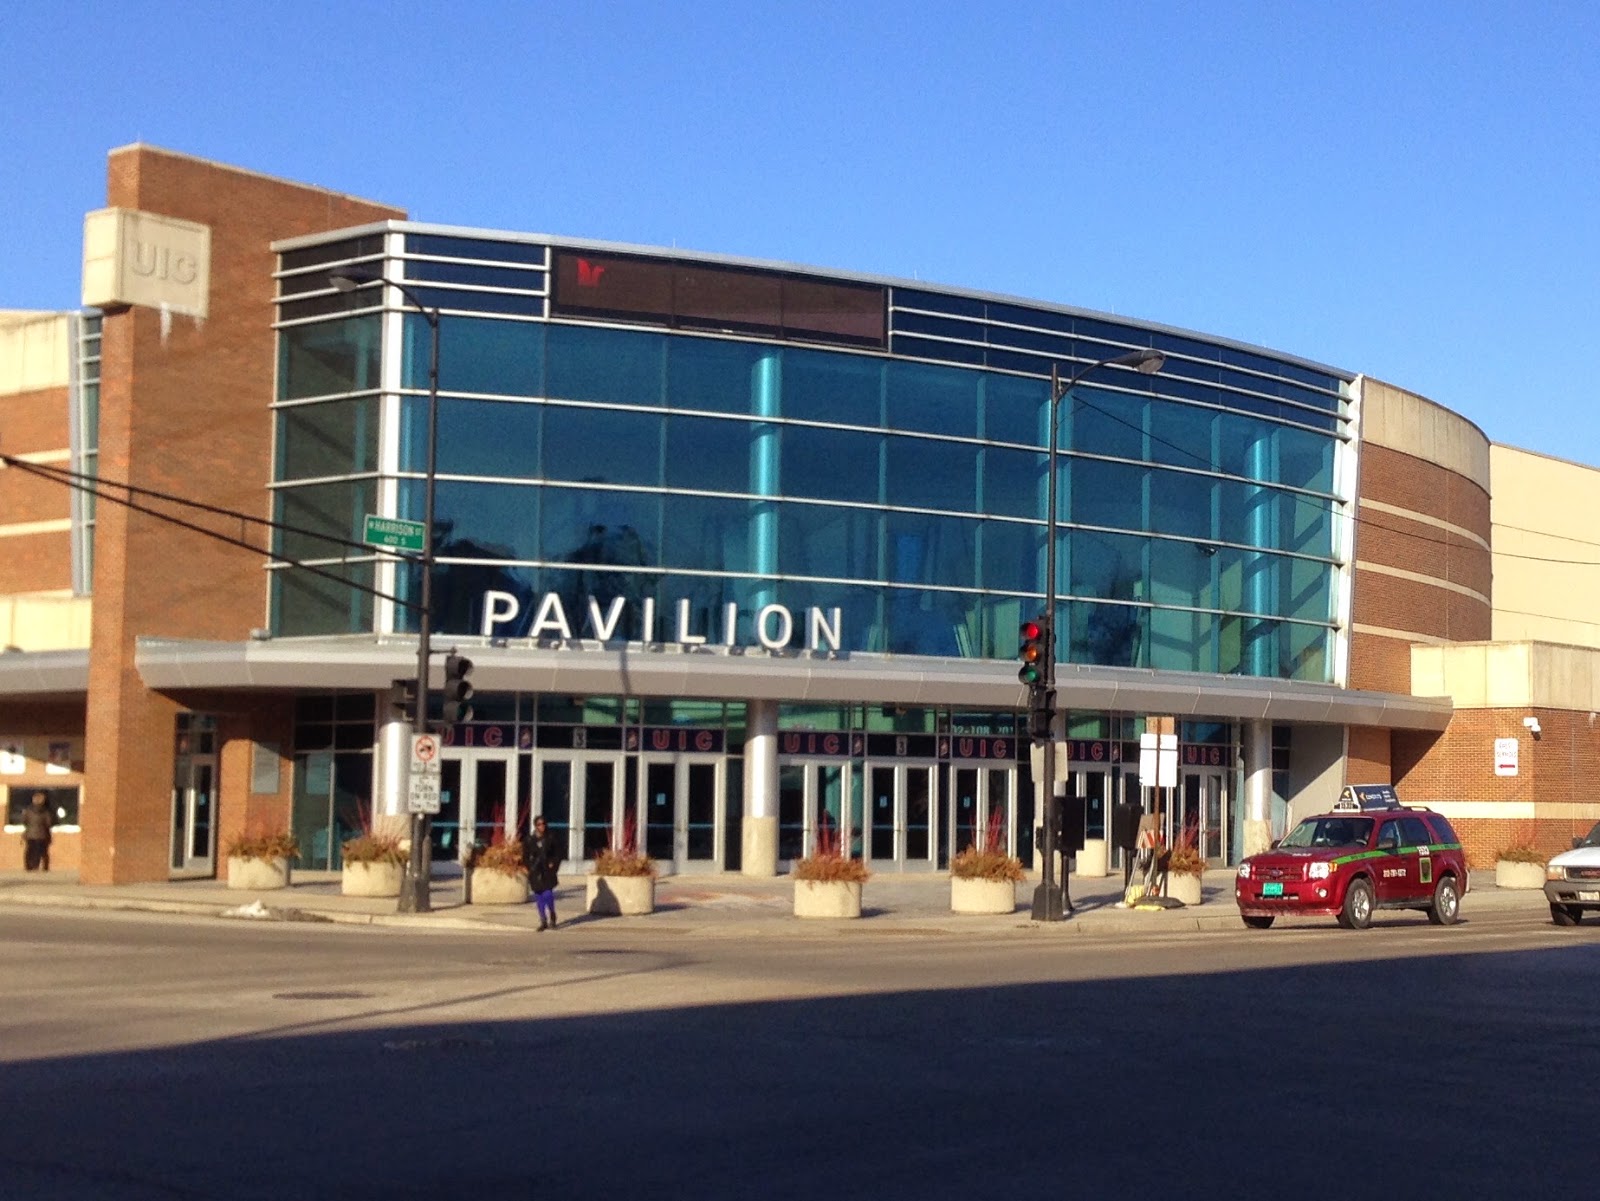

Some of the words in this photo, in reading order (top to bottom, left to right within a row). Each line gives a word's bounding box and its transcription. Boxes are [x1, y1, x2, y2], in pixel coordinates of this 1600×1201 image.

[131, 241, 198, 285] UIC
[480, 590, 842, 651] PAVILION
[436, 724, 503, 748] UIC
[652, 730, 713, 751] UIC
[783, 733, 840, 754] UIC
[959, 738, 1007, 758] UIC
[1187, 747, 1220, 765] UIC
